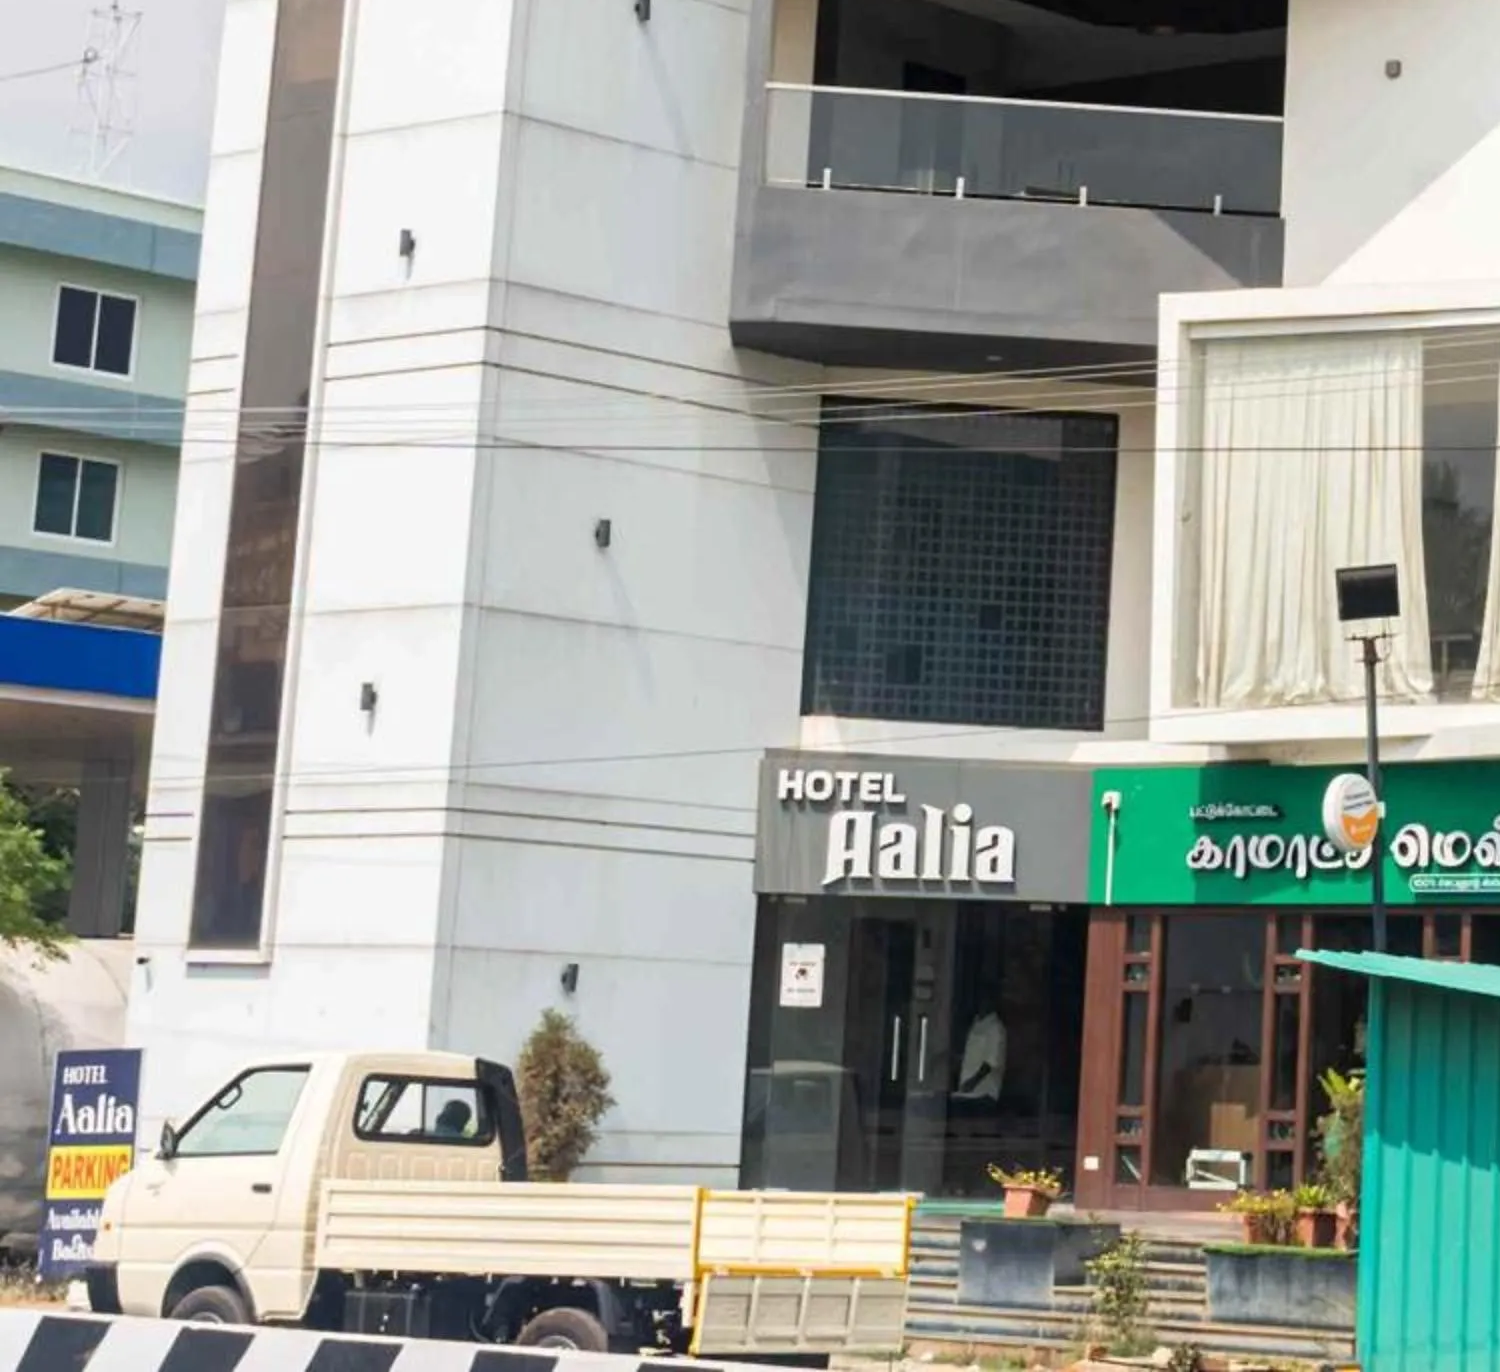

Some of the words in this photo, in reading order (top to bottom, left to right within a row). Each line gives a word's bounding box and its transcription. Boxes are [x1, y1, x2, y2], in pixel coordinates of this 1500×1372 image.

[777, 769, 906, 804] HOTEL
[821, 803, 1017, 886] Aalia
[63, 1065, 108, 1085] HOTEL
[54, 1093, 134, 1135] Aalia
